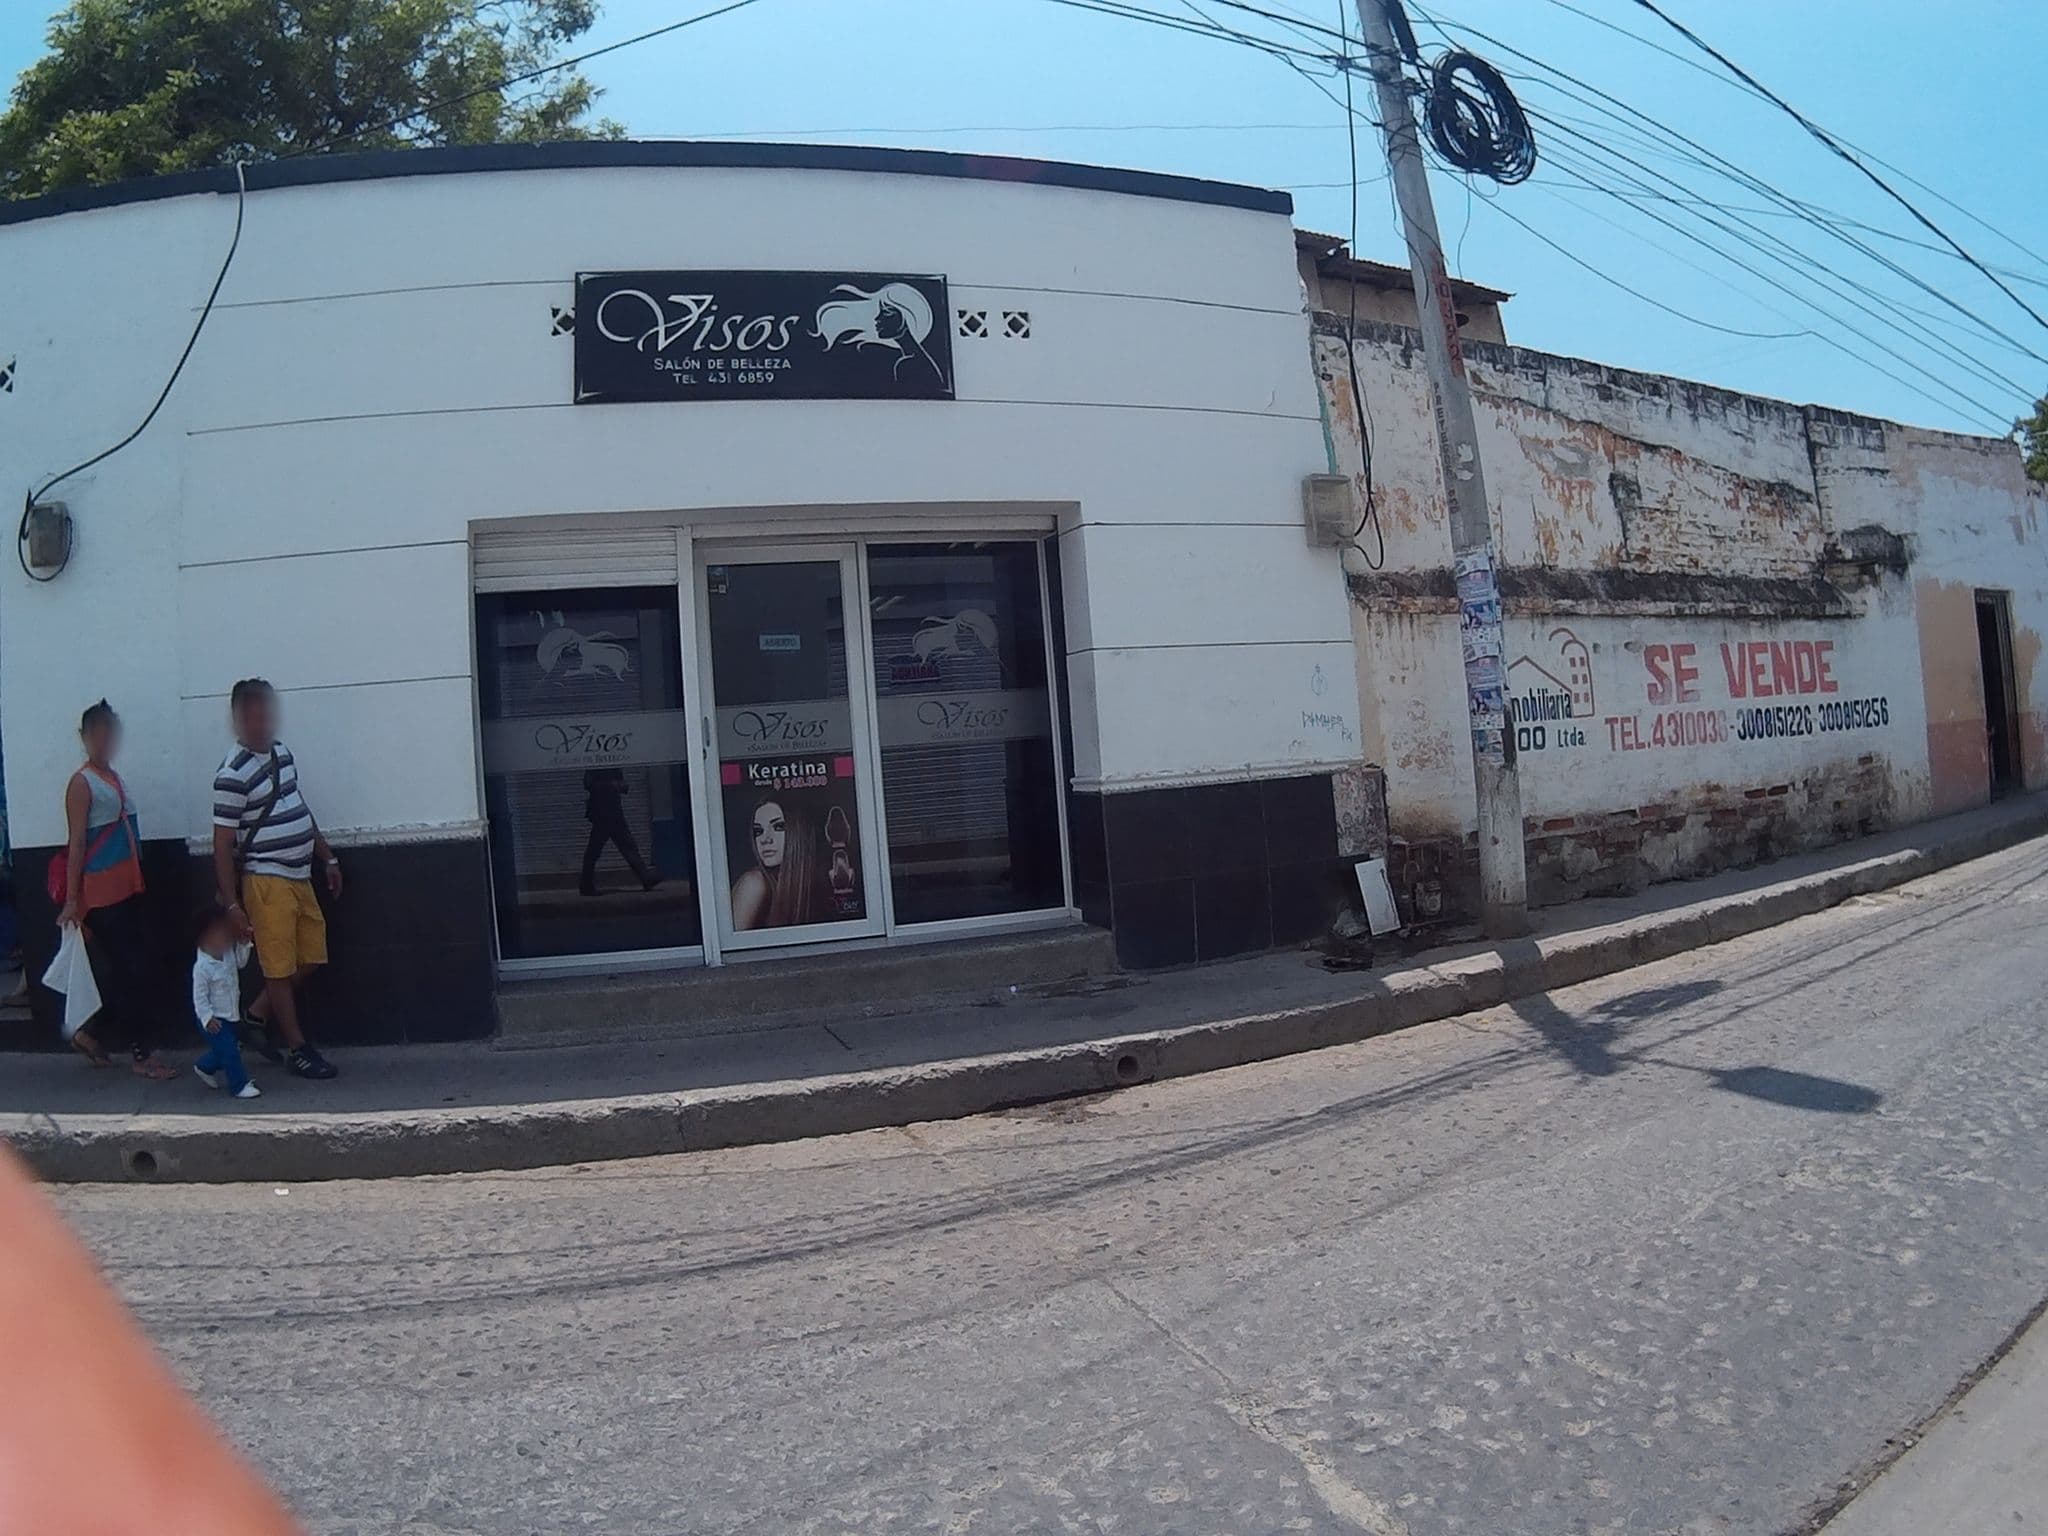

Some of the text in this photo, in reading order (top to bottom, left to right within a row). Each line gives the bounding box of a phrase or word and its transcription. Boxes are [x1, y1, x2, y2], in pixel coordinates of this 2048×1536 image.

[597, 289, 800, 351] Visos
[708, 359, 725, 370] DE
[731, 359, 792, 370] BELLEZA
[738, 371, 775, 384] 6859
[1643, 641, 1838, 706] SE VENDE
[732, 711, 828, 741] Visos
[917, 701, 1008, 729] Visos
[535, 724, 632, 753] Visos
[748, 760, 827, 778] Keratina
